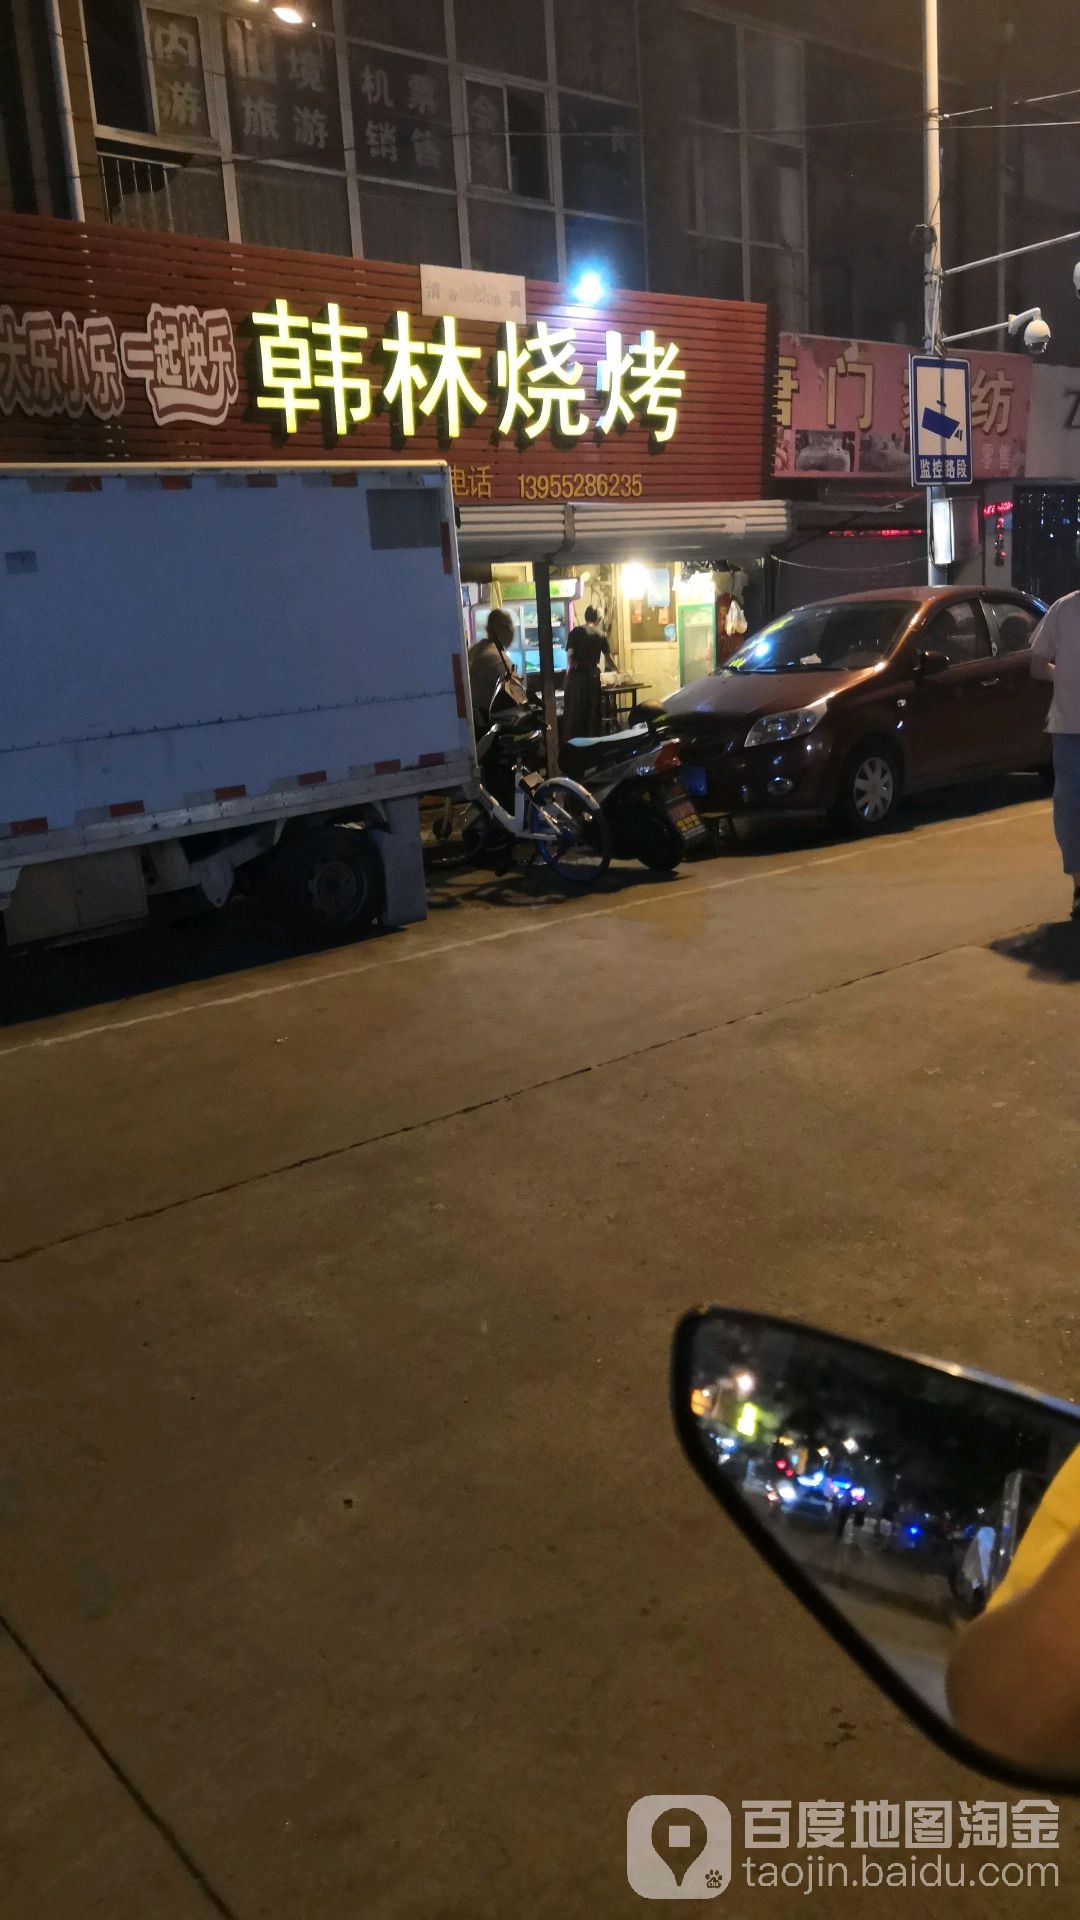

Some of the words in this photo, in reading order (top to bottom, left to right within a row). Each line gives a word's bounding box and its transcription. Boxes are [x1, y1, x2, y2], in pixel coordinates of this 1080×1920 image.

[251, 299, 686, 444] 韩林烧烤
[451, 465, 493, 498] 电话
[518, 474, 643, 499] 13955286235
[919, 458, 968, 480] 监控路段
